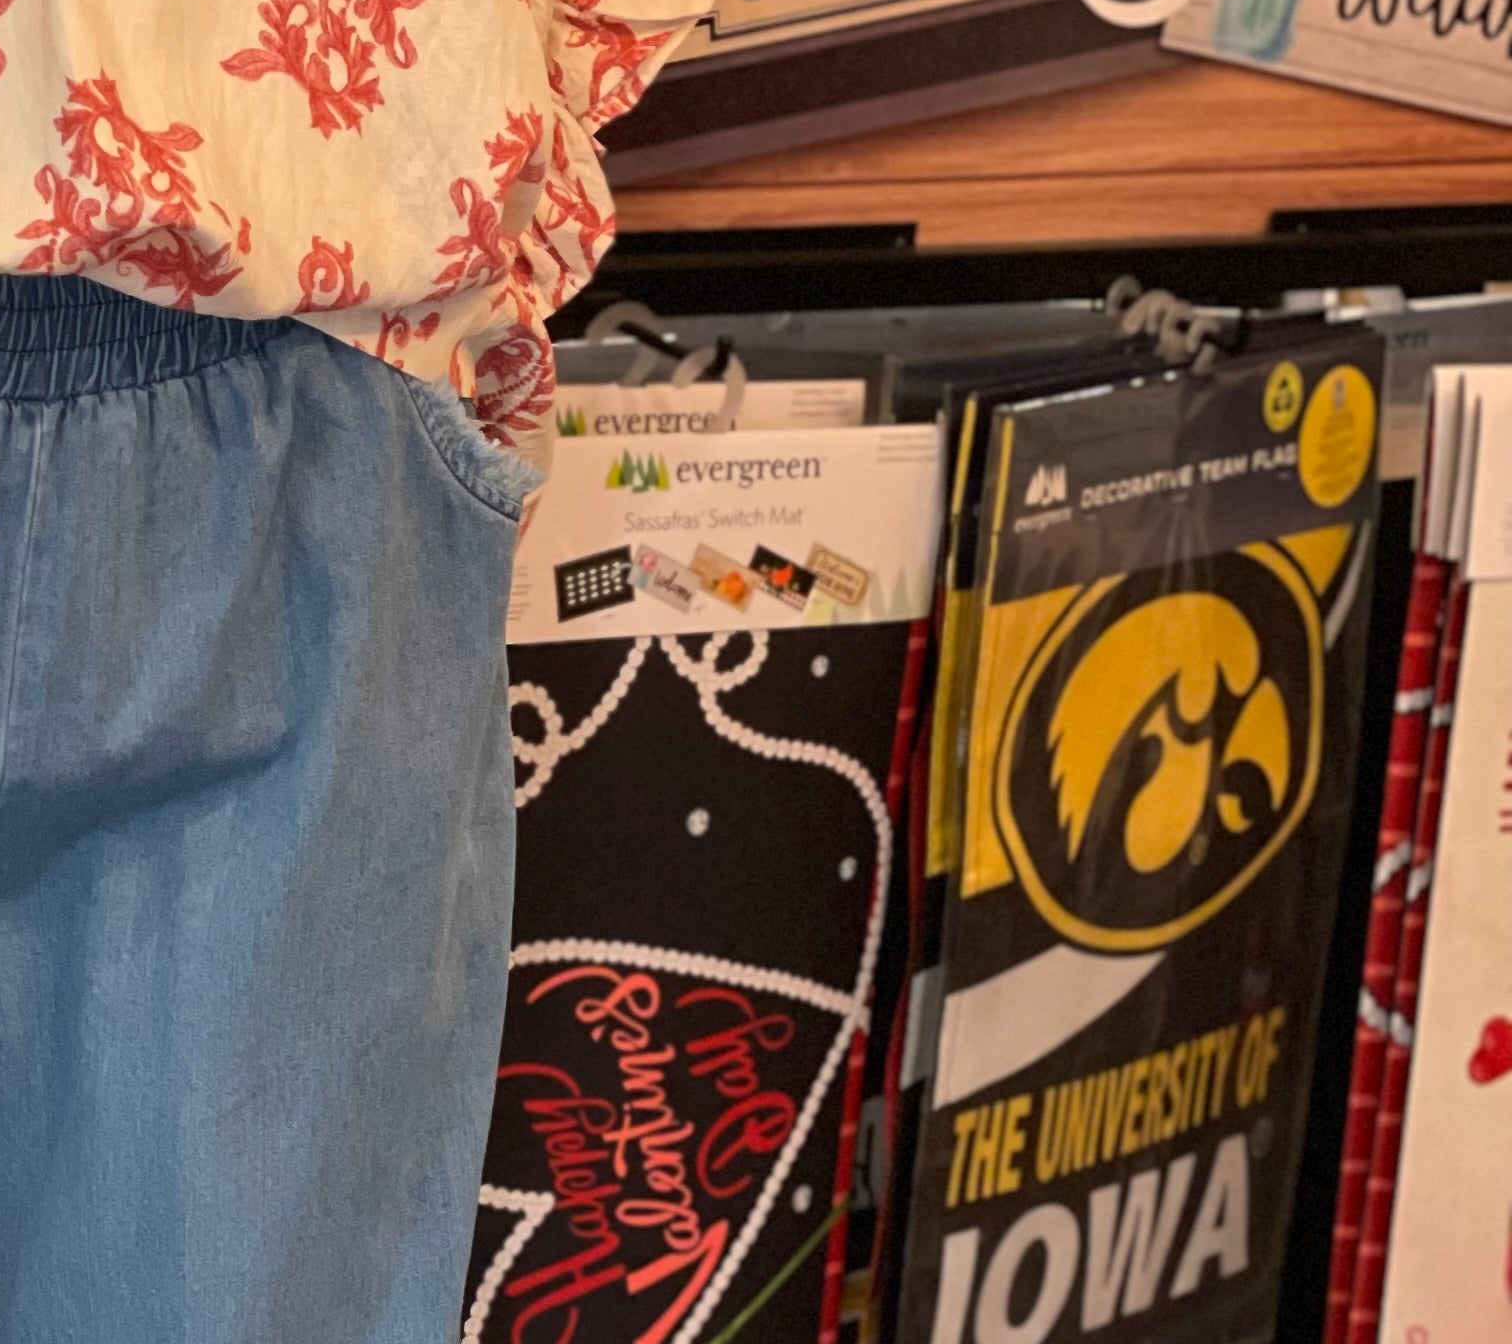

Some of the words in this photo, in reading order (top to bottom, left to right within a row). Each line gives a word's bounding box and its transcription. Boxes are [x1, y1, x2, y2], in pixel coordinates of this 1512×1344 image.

[675, 456, 823, 490] evergreen
[1080, 464, 1194, 509] DECORATIVE
[1199, 454, 1249, 484] TEAM
[707, 506, 766, 530] Switch
[675, 987, 797, 1199] Day
[945, 1093, 1034, 1209] THE
[1034, 1023, 1240, 1184] UNIVERSITY
[1235, 1005, 1287, 1109] OF
